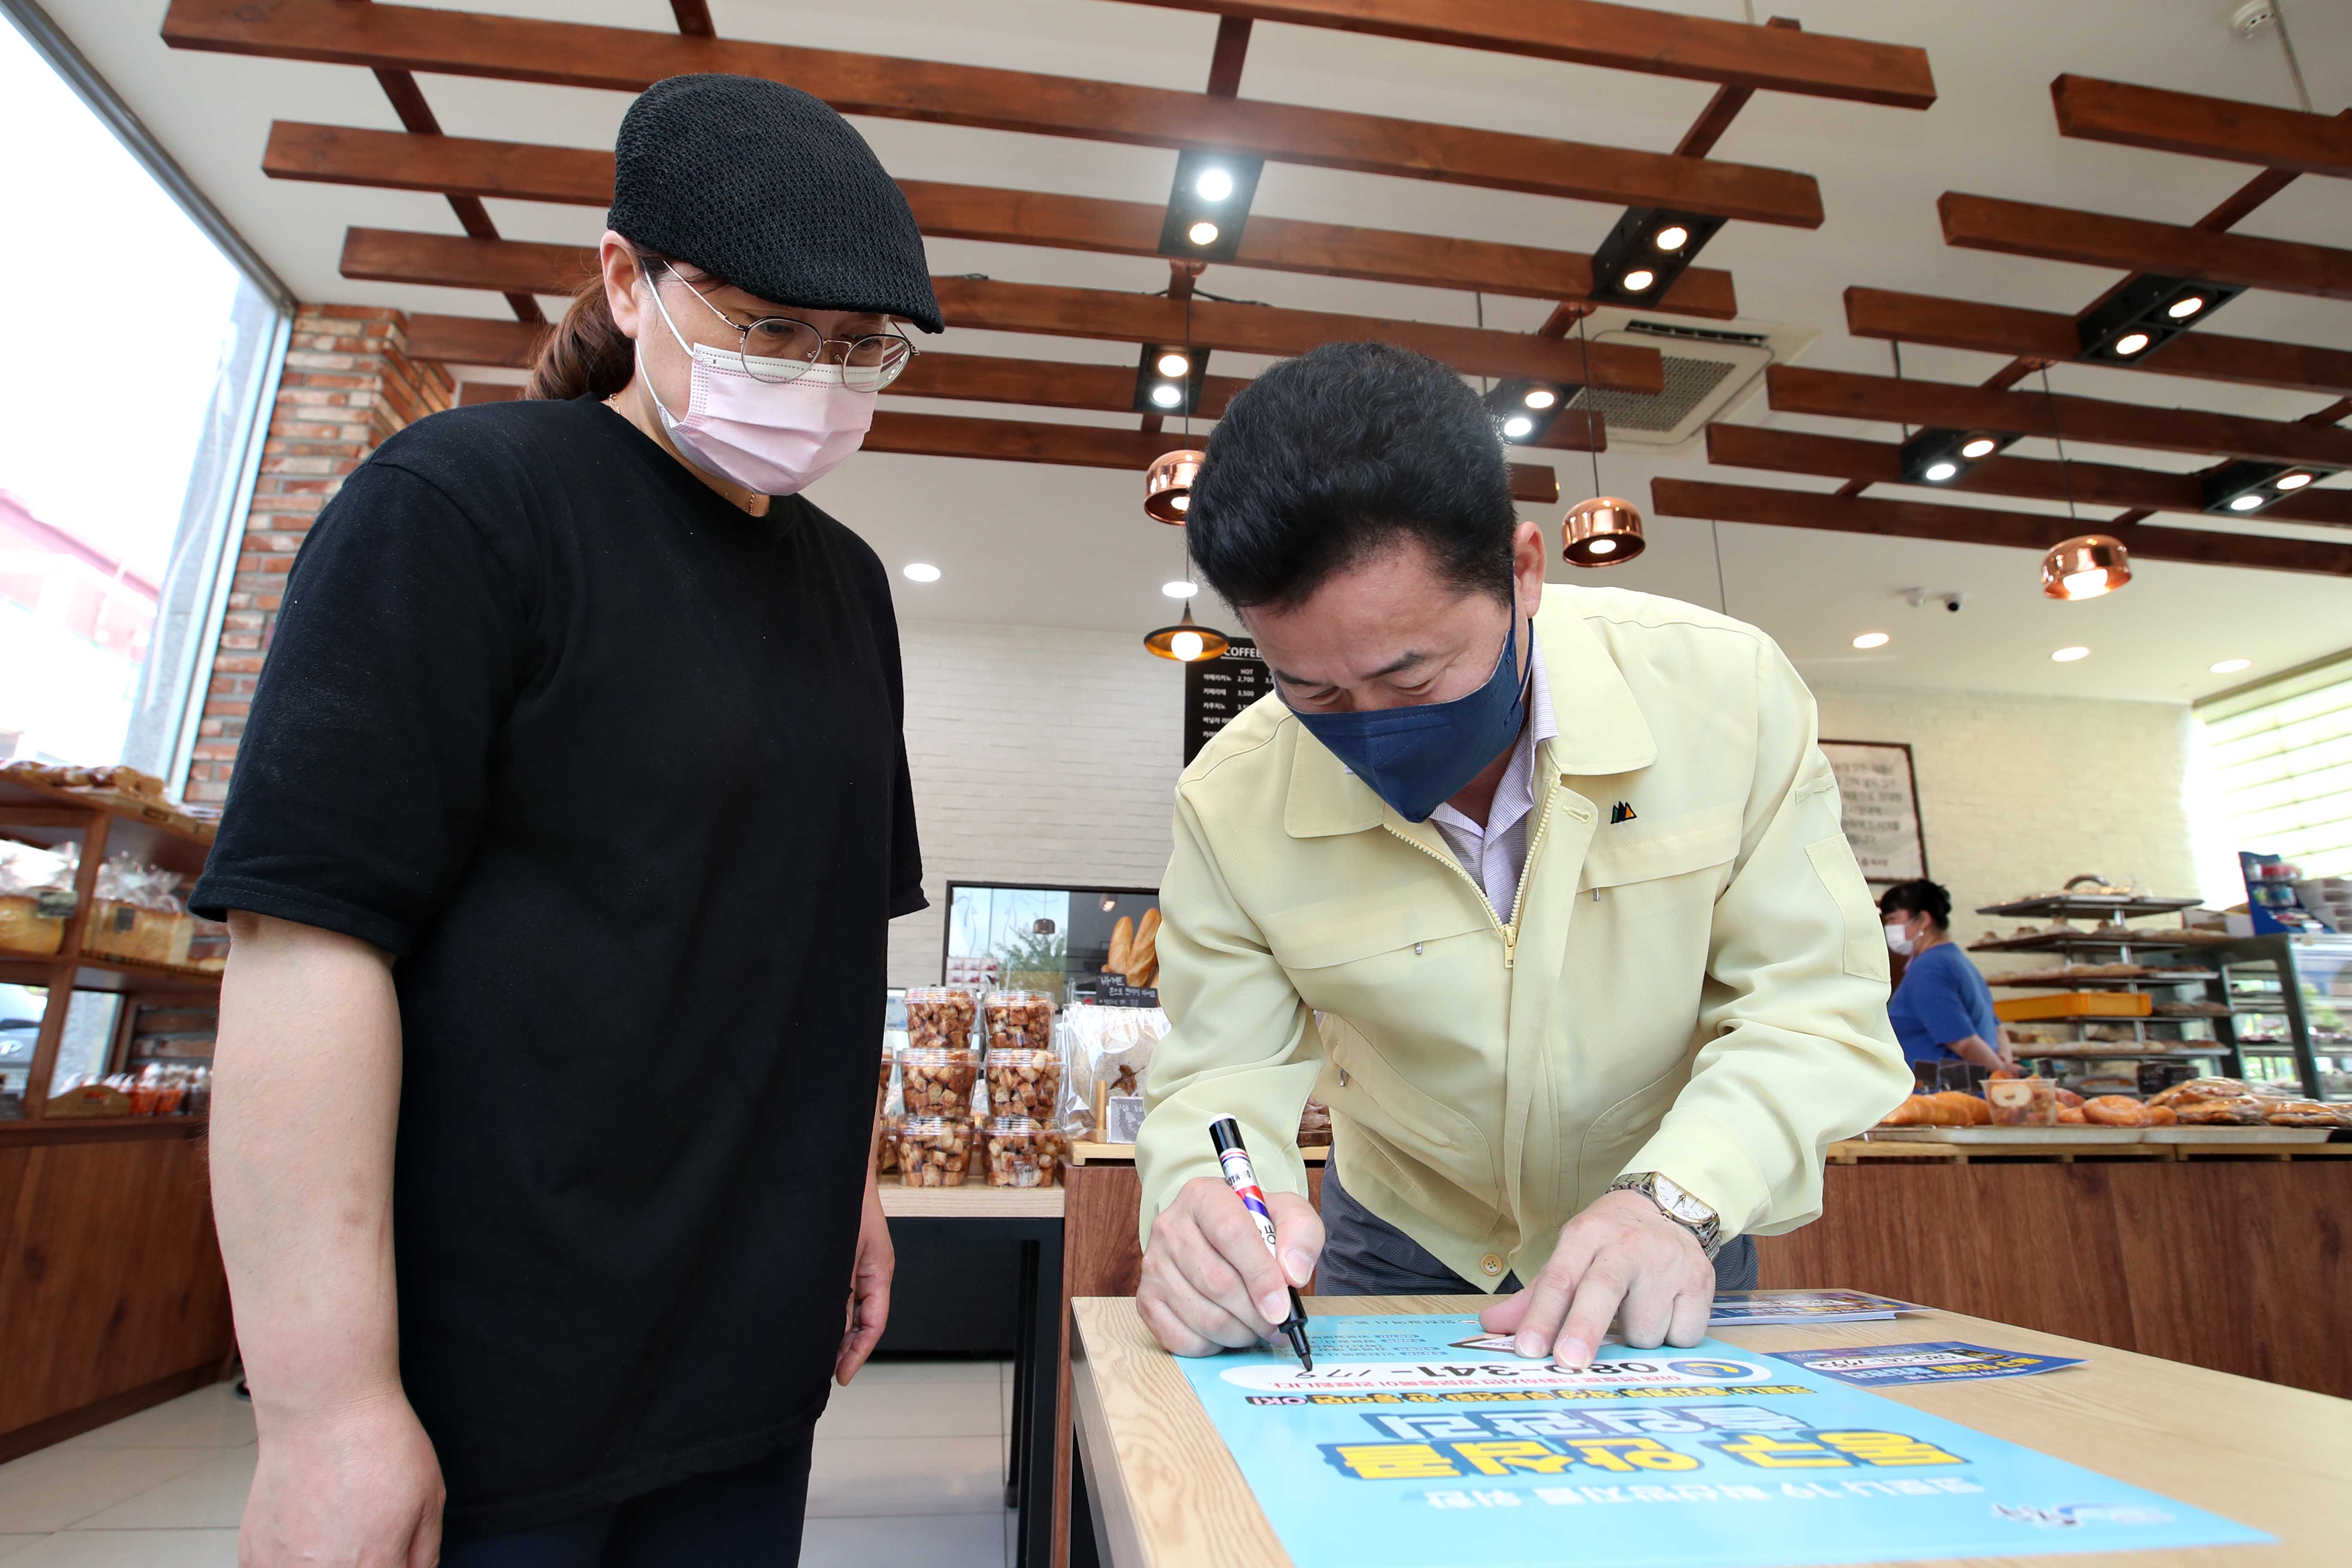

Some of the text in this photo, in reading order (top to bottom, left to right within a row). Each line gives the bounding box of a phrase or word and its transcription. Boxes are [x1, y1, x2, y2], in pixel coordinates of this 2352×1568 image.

[1251, 1396, 1307, 1405] OK!
[1375, 1405, 1810, 1440] 출입관리
[1335, 1431, 1967, 1480] 동구 안심콜
